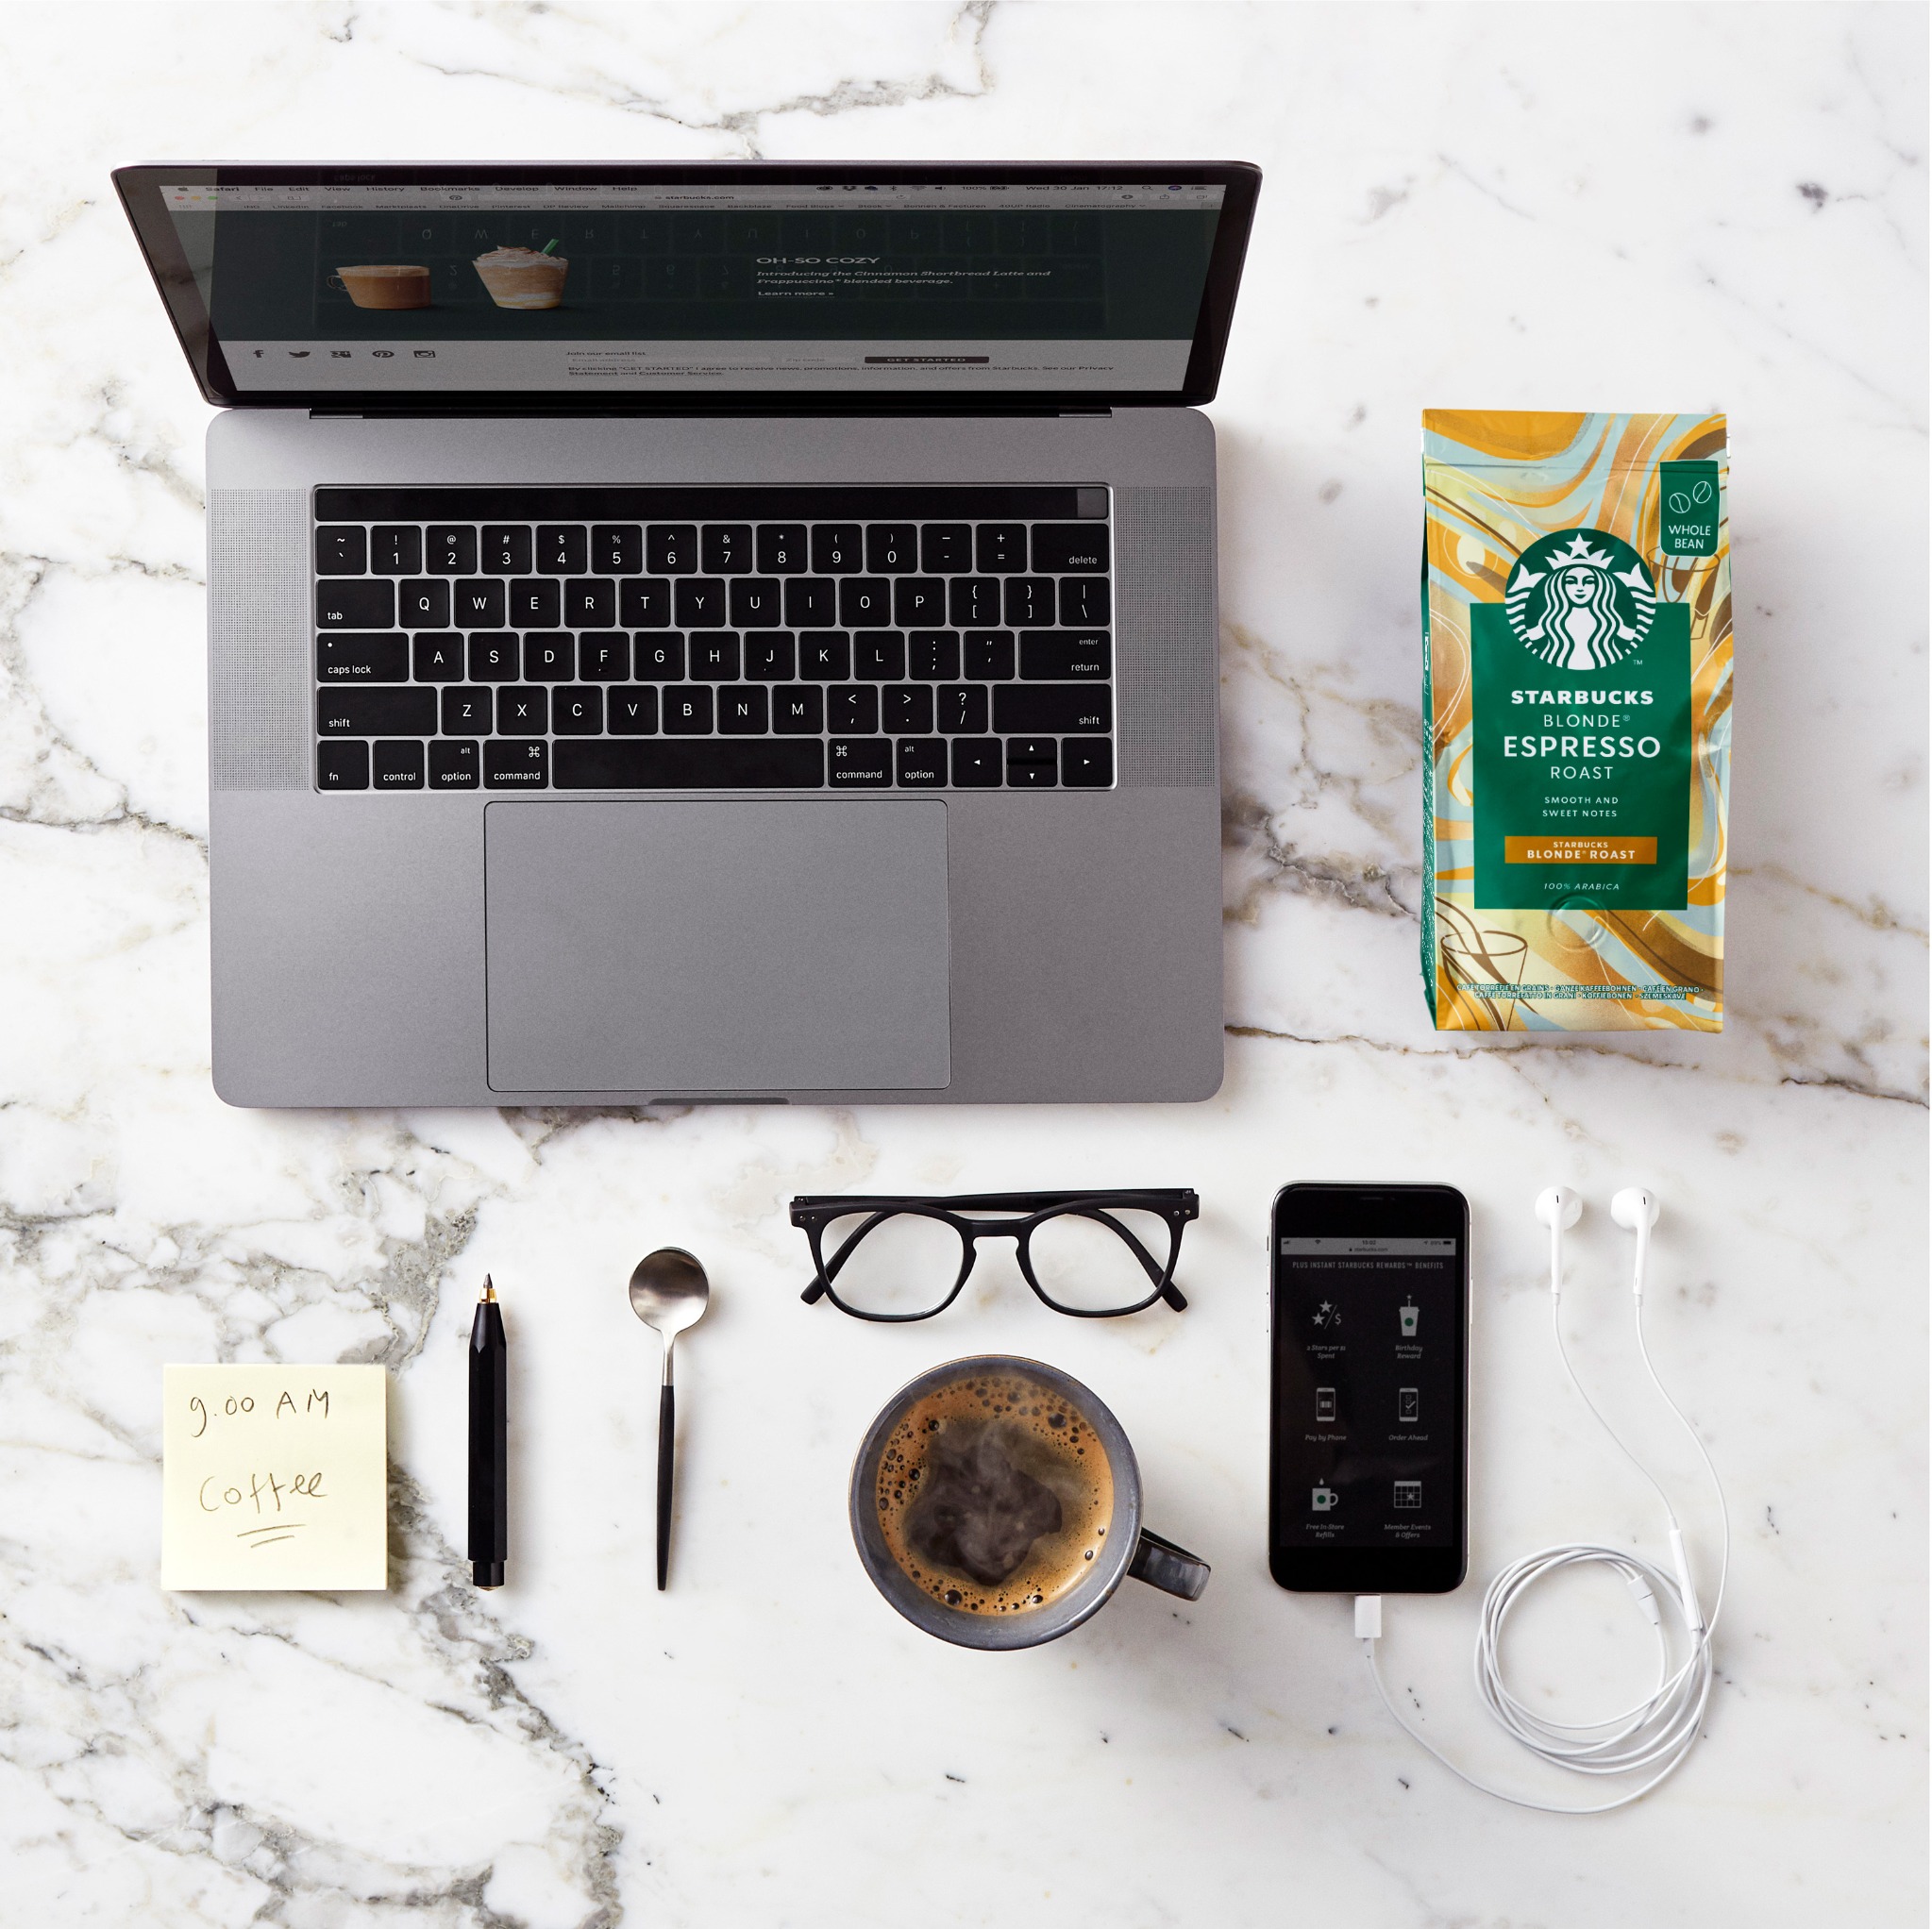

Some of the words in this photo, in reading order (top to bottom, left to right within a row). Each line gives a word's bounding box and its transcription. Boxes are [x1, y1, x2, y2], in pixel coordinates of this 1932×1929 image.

[1668, 525, 1711, 536] WHOLE
[1674, 538, 1705, 549] BEAN
[393, 552, 399, 565] 1
[447, 551, 457, 565] 2
[502, 551, 512, 565] 3
[557, 551, 566, 564] 4
[613, 551, 622, 564] 5
[666, 551, 677, 564] 6
[723, 551, 731, 563] 7
[777, 550, 787, 564] 8
[832, 550, 842, 563] 9
[1068, 555, 1098, 564] delete
[418, 596, 430, 612] Q
[472, 596, 487, 610] W
[530, 596, 539, 610] E
[585, 596, 595, 610] R
[640, 596, 650, 610] T
[695, 596, 705, 610] Y
[749, 595, 761, 610] U
[860, 595, 870, 609] O
[915, 595, 925, 609] P
[327, 611, 344, 620] tab
[433, 650, 445, 664] A
[489, 649, 499, 663] S
[544, 649, 555, 663] D
[599, 649, 609, 663] F
[654, 649, 665, 663] G
[709, 649, 720, 663] H
[765, 649, 774, 663] J
[819, 648, 829, 663] K
[875, 649, 884, 663] L
[328, 666, 350, 676] caps
[352, 664, 372, 674] lock
[1070, 663, 1100, 672] return
[1511, 689, 1655, 706] STARBUCKS
[462, 704, 472, 717] Z
[517, 703, 528, 717] X
[572, 703, 582, 717] C
[627, 703, 638, 716] V
[682, 703, 693, 716] B
[737, 703, 748, 716] N
[791, 702, 804, 715] M
[328, 718, 350, 728] shift
[1078, 715, 1100, 725] shift
[460, 746, 471, 755] alt
[904, 745, 915, 753] alt
[1504, 735, 1661, 758] ESPRESSO
[328, 772, 339, 781] fn
[382, 772, 416, 781] control
[441, 771, 472, 782] option
[494, 771, 541, 780] command
[835, 769, 882, 780] command
[904, 769, 934, 780] option
[1550, 766, 1614, 780] ROAST
[1589, 849, 1636, 860] ROAST
[1543, 882, 1571, 891] 100%
[1573, 882, 1621, 891] ARABICA
[1292, 1261, 1308, 1269] PLUS
[1310, 1261, 1336, 1269] INSTANT
[1337, 1261, 1374, 1269] STARBUCKS
[1415, 1261, 1444, 1269] BENEFITS
[1395, 1344, 1423, 1352] Birthday
[1304, 1434, 1318, 1442] Pay
[1318, 1434, 1327, 1442] by
[199, 1471, 328, 1515] Coffee
